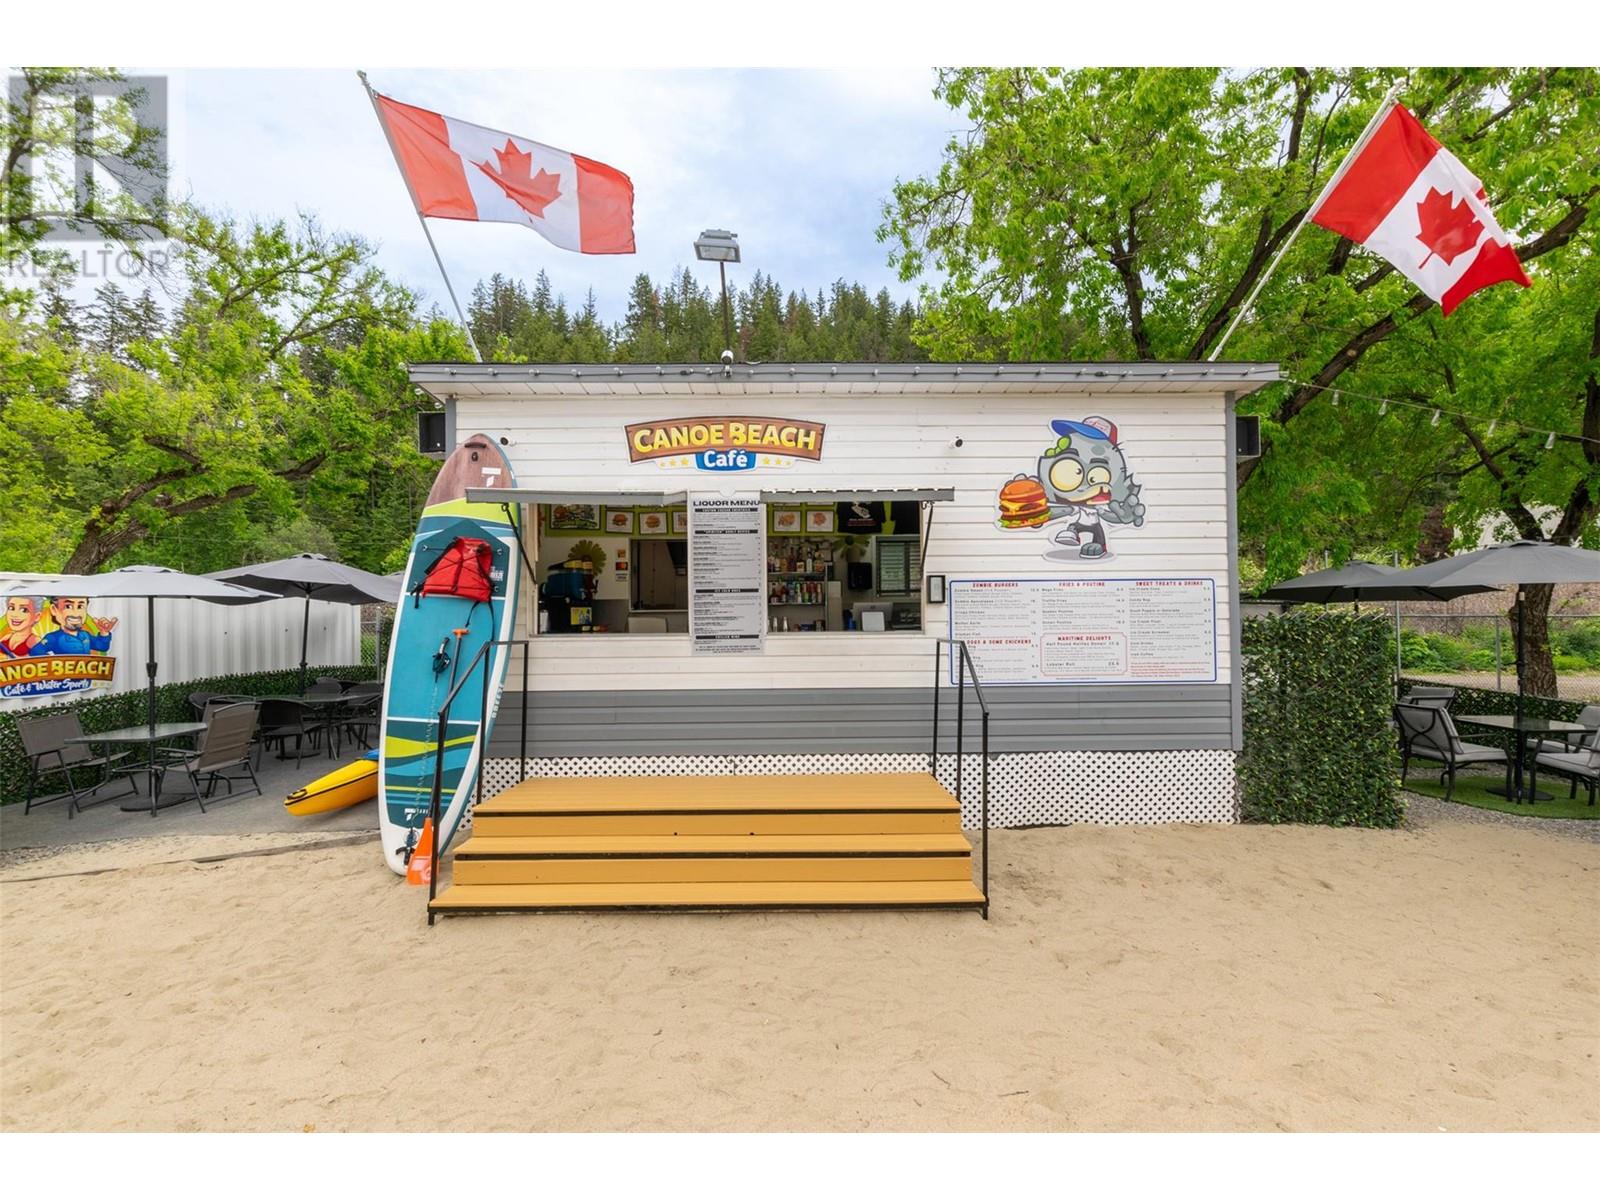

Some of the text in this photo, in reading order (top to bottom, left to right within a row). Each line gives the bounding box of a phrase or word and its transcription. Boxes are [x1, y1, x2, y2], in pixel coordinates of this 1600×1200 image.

[633, 421, 817, 454] CANOE BEACH
[703, 450, 748, 468] Café
[51, 660, 110, 677] BEACH
[32, 680, 60, 692] Water
[62, 678, 89, 692] Sports
